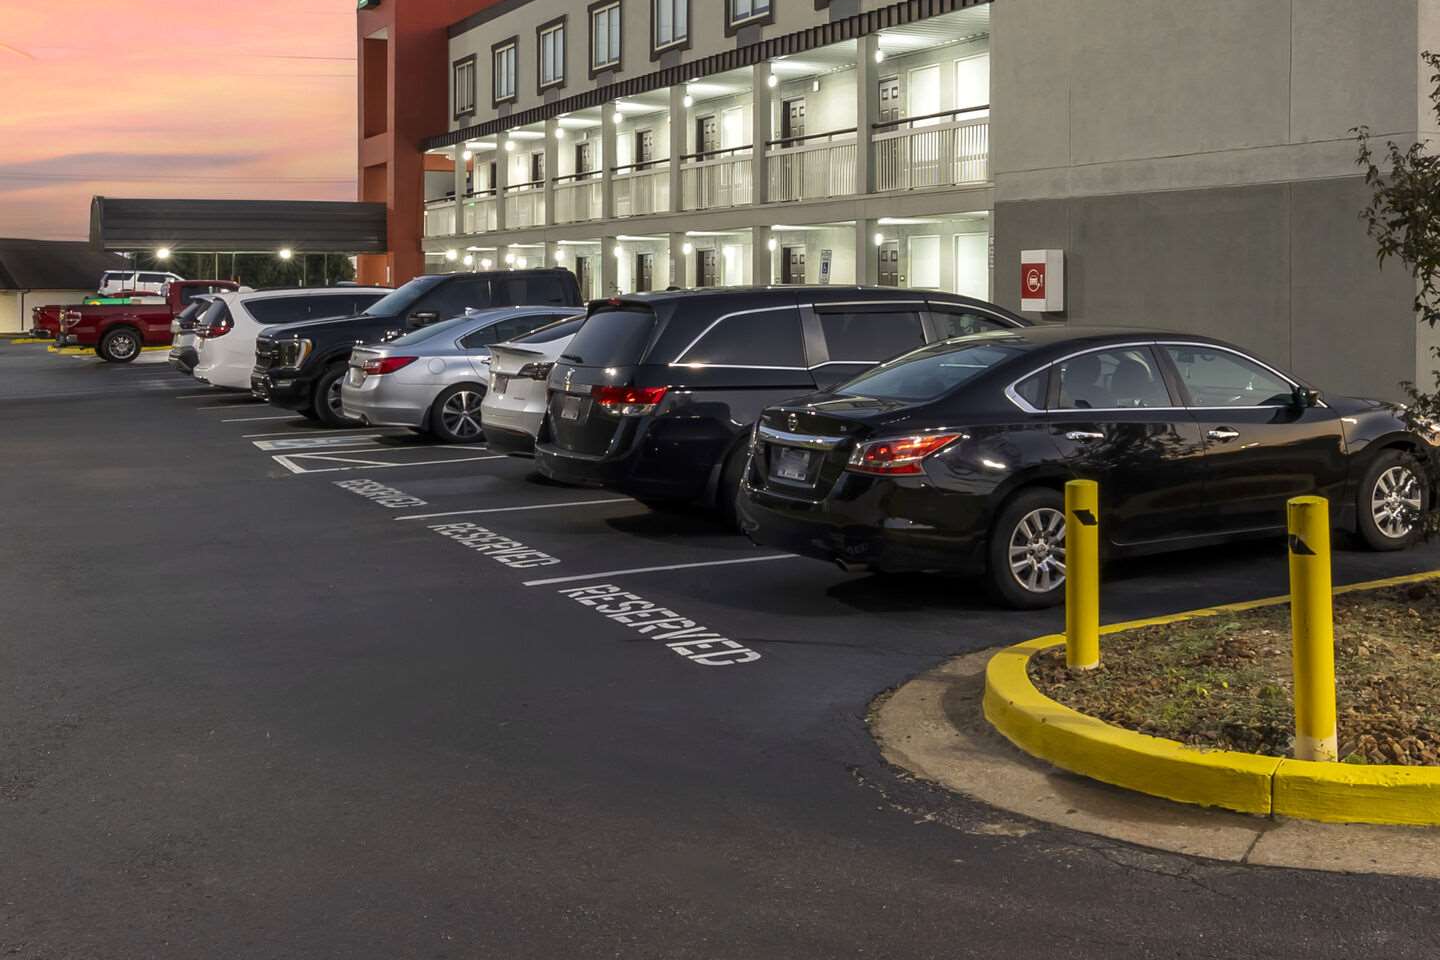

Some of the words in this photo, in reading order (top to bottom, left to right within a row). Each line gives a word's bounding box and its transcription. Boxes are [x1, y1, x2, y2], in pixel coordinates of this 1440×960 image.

[331, 478, 428, 508] RESERVED
[427, 522, 561, 568] RESERVED
[558, 584, 762, 666] RESERVED
